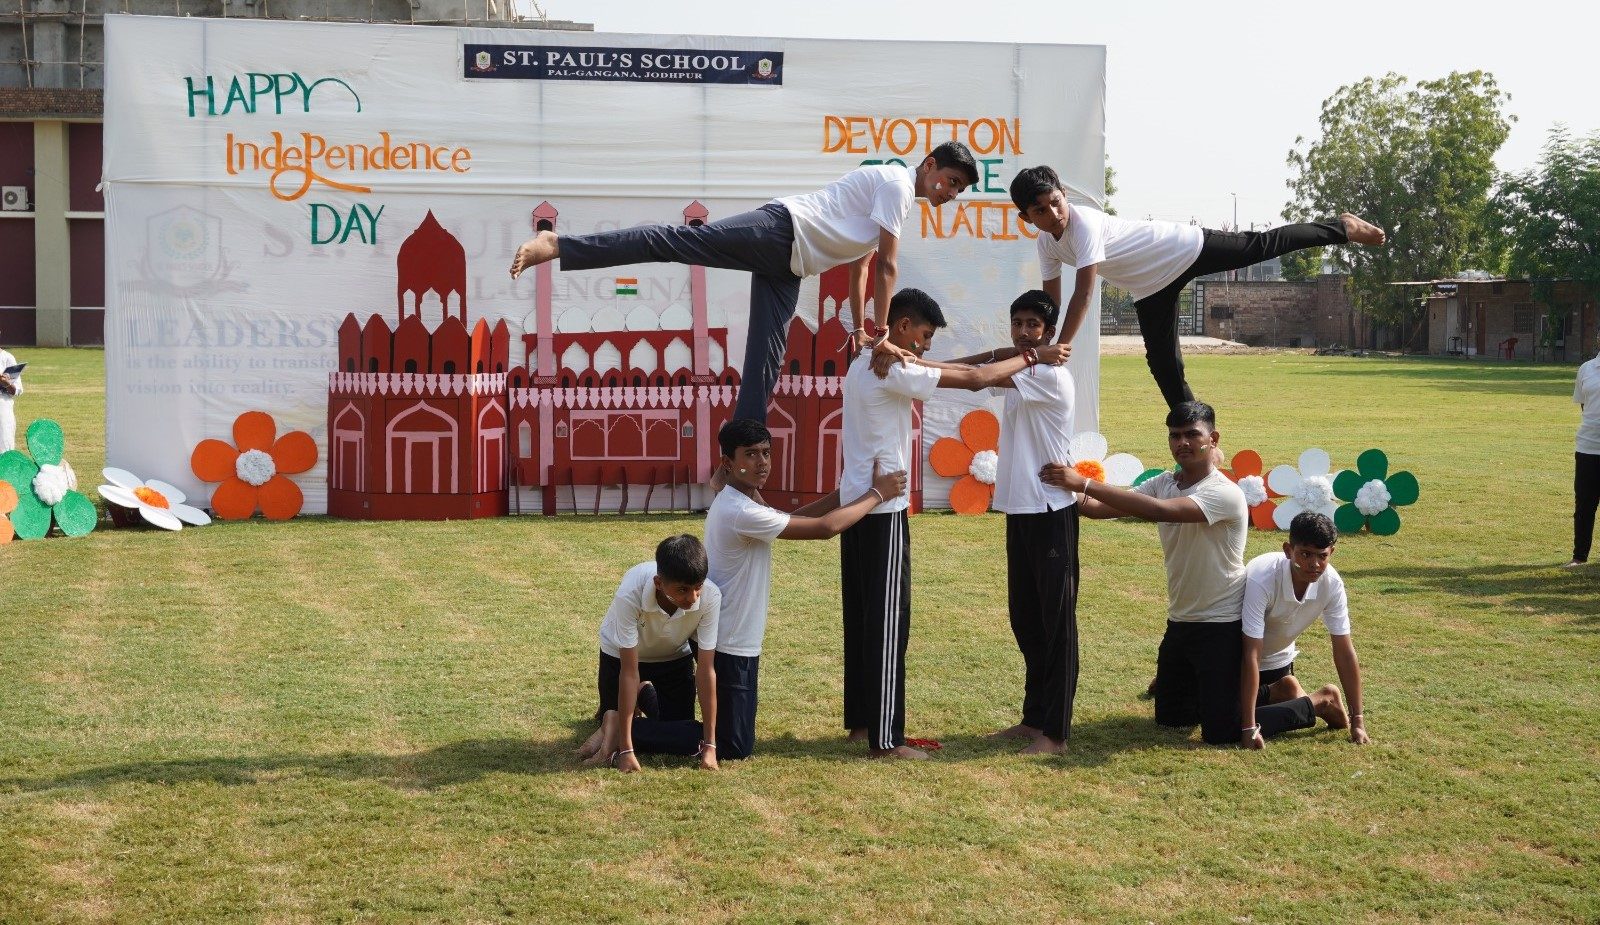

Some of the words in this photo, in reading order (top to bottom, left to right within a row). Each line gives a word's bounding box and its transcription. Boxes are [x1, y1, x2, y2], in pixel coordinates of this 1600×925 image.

[503, 50, 539, 66] ST.
[545, 51, 633, 68] PAUL'S
[640, 53, 746, 71] SCHOOL
[547, 69, 642, 79] PAL-GANGANA,
[644, 71, 703, 80] JODHPUR
[184, 73, 361, 117] HAPPY
[310, 203, 385, 246] DAY
[147, 354, 177, 369] the
[183, 354, 242, 373] ability
[248, 356, 267, 369] to
[127, 379, 182, 394] vision
[189, 380, 226, 394] into
[232, 379, 296, 398] reality.
